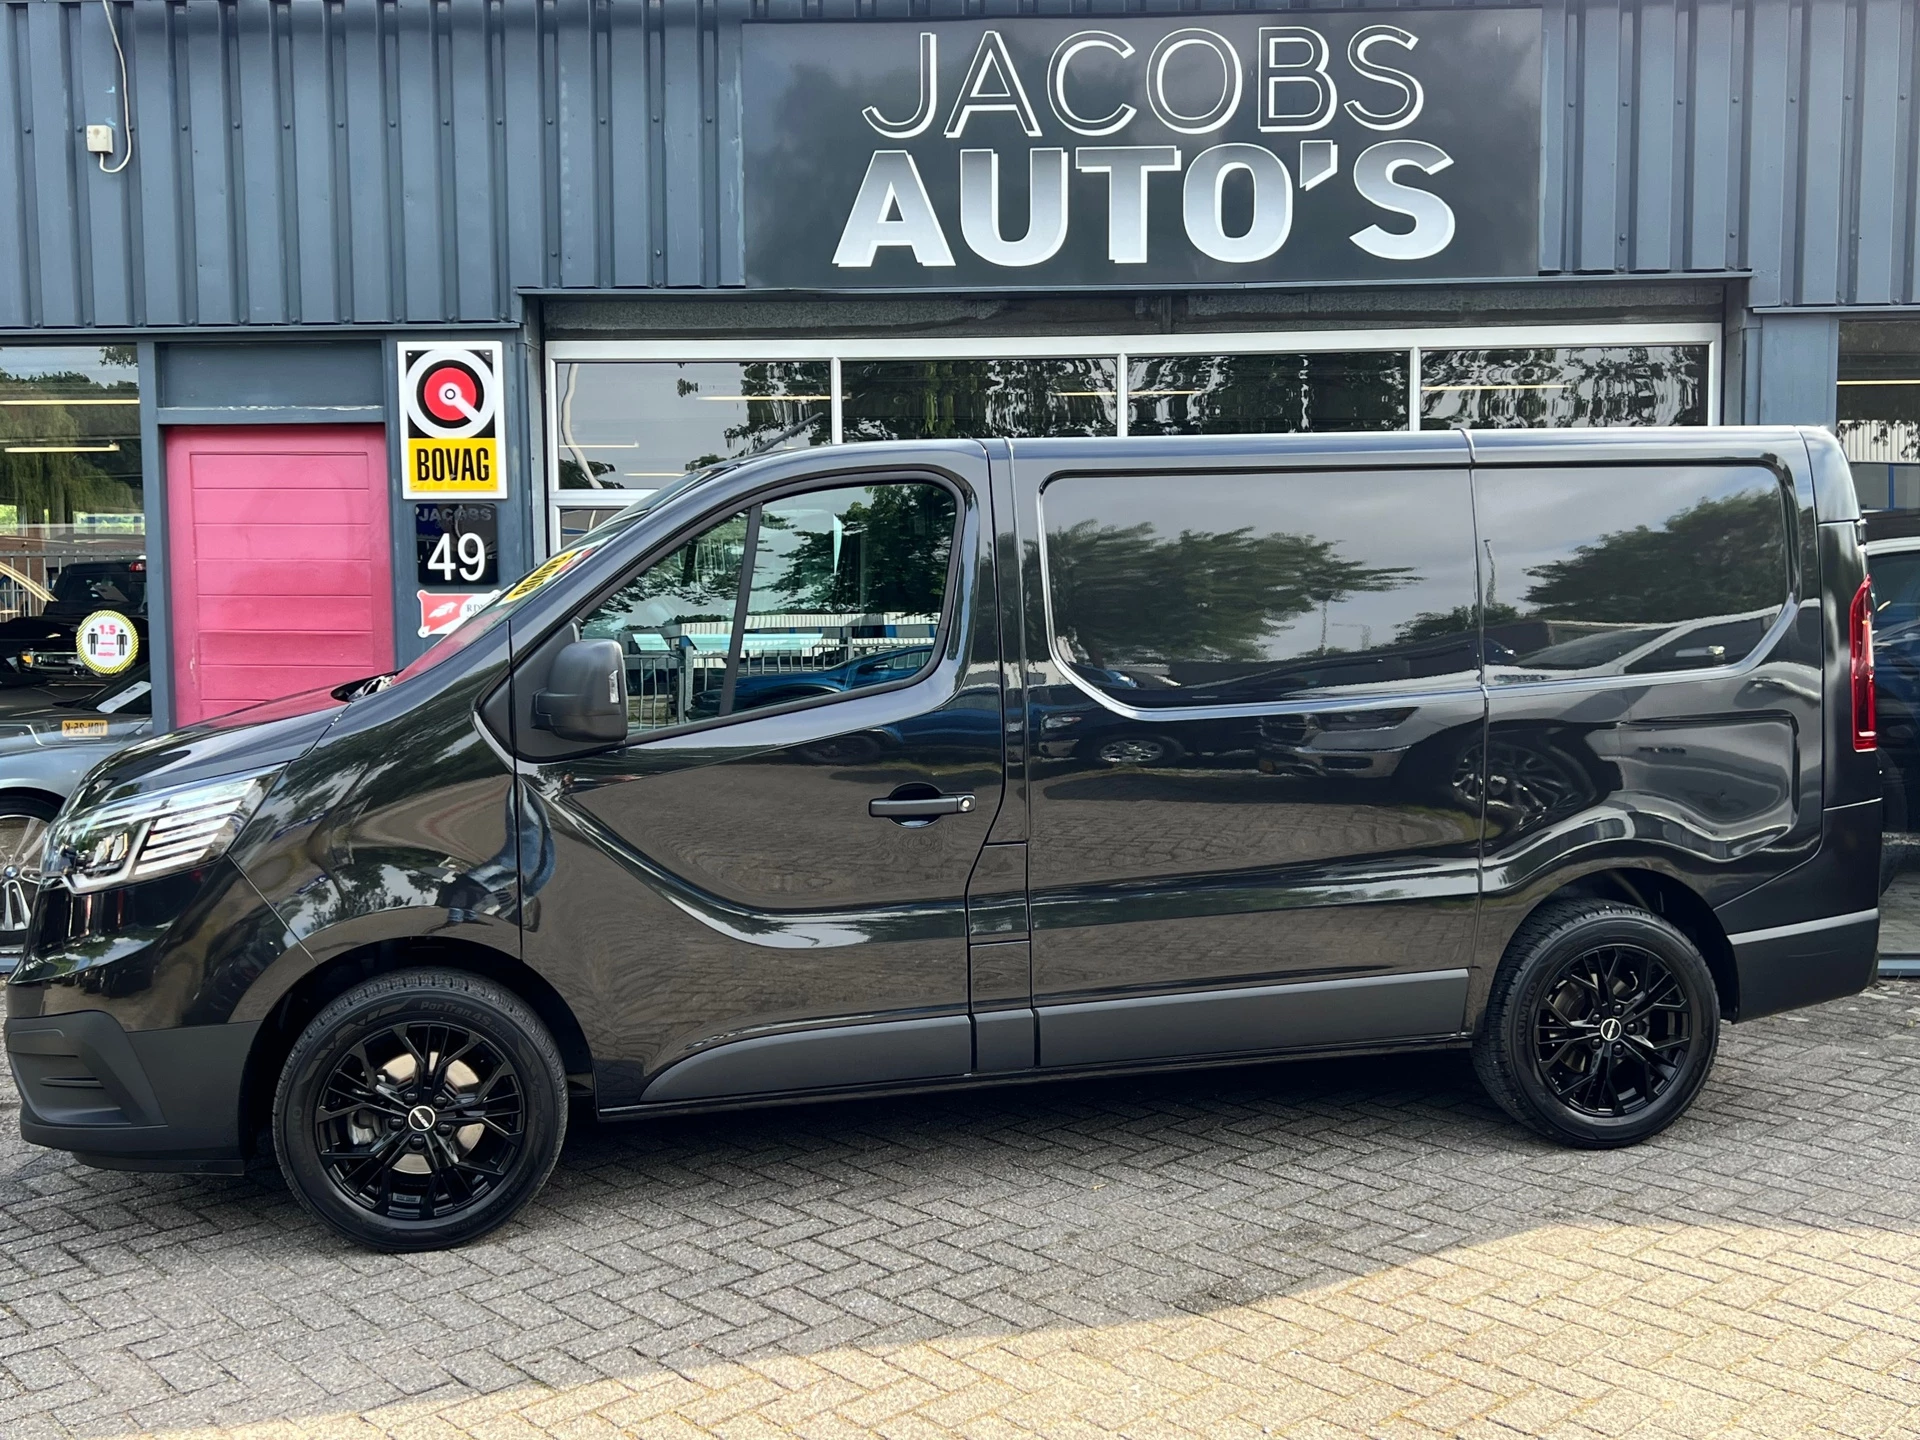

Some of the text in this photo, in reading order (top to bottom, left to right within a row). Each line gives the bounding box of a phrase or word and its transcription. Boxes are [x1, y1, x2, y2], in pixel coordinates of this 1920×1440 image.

[862, 24, 1424, 139] JACOBS
[831, 139, 1456, 267] AUTO'S
[416, 447, 490, 482] BOVAG
[418, 507, 492, 522] JACOBS
[427, 532, 486, 581] 49
[466, 604, 485, 613] RD
[99, 624, 117, 635] 1.5
